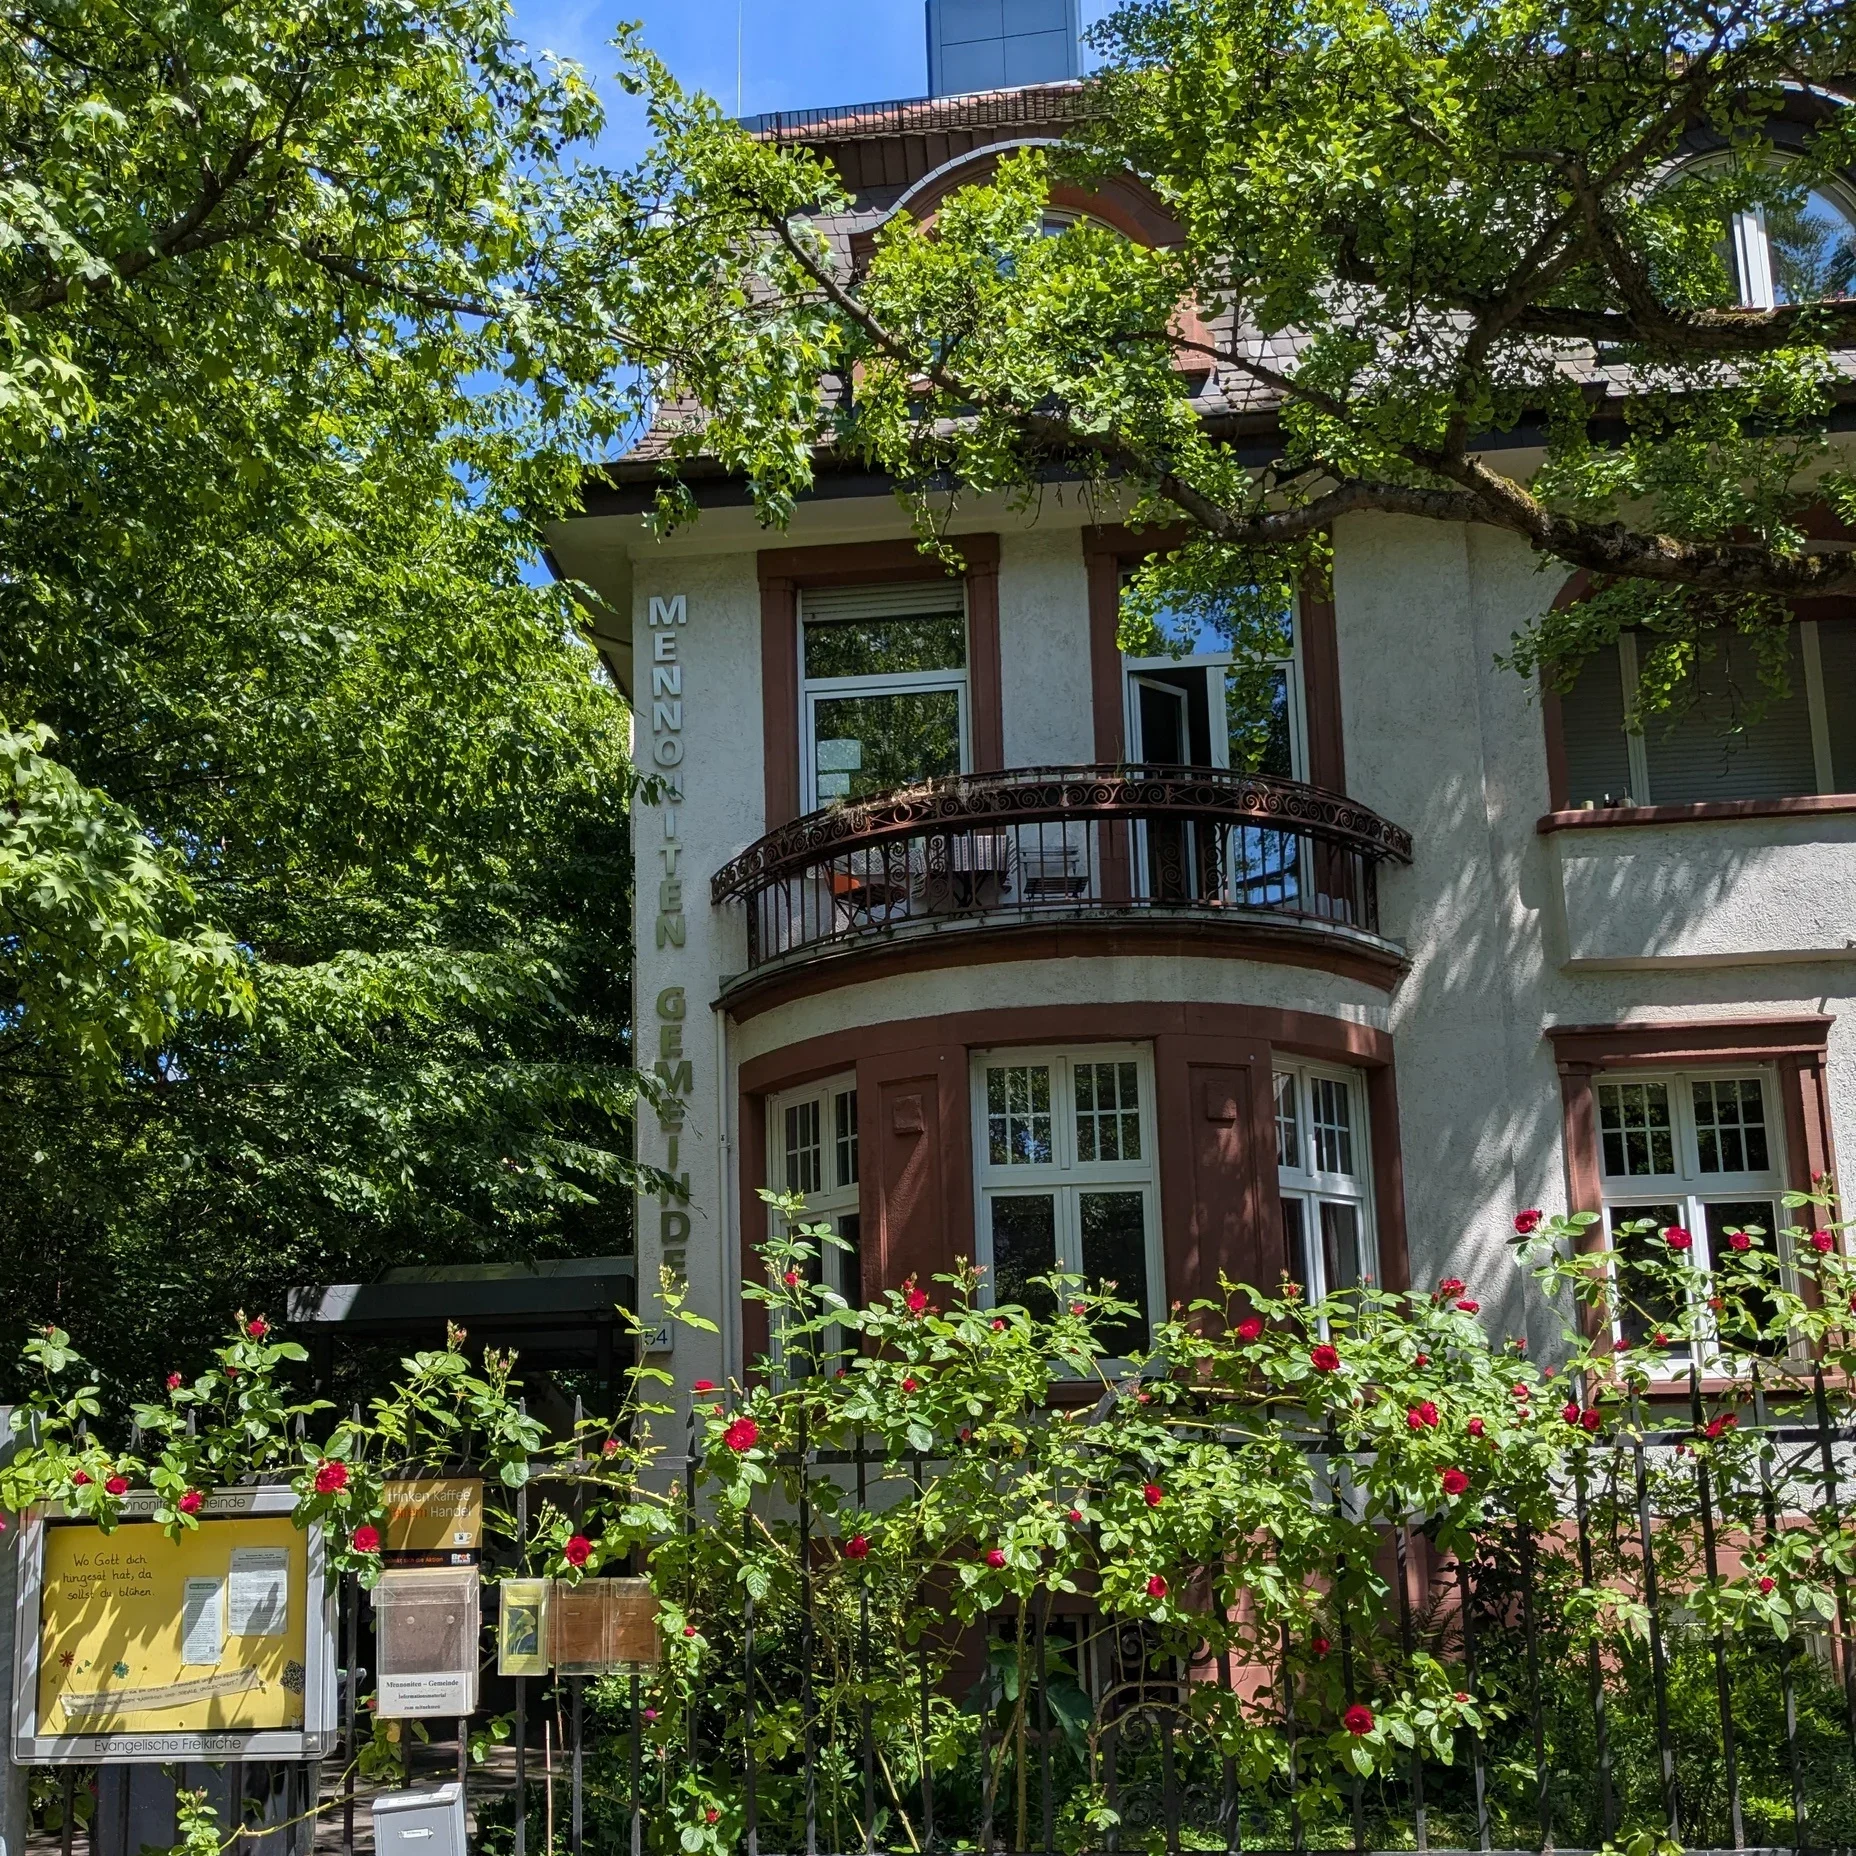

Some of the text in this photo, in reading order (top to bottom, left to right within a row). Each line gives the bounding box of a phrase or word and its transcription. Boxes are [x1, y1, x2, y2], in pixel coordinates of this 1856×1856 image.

[648, 594, 694, 1282] MENNONITEN GEMEINDE
[644, 1328, 668, 1346] 54
[200, 1495, 246, 1509] einde
[387, 1489, 471, 1503] trinken Kaffee
[430, 1504, 472, 1518] Handel
[73, 1552, 148, 1567] Wo Gott dich
[112, 1567, 134, 1581] hat,
[138, 1567, 153, 1580] da
[67, 1586, 156, 1600] sollst du blühen.
[94, 1737, 241, 1754] Evangelische Freikirche
